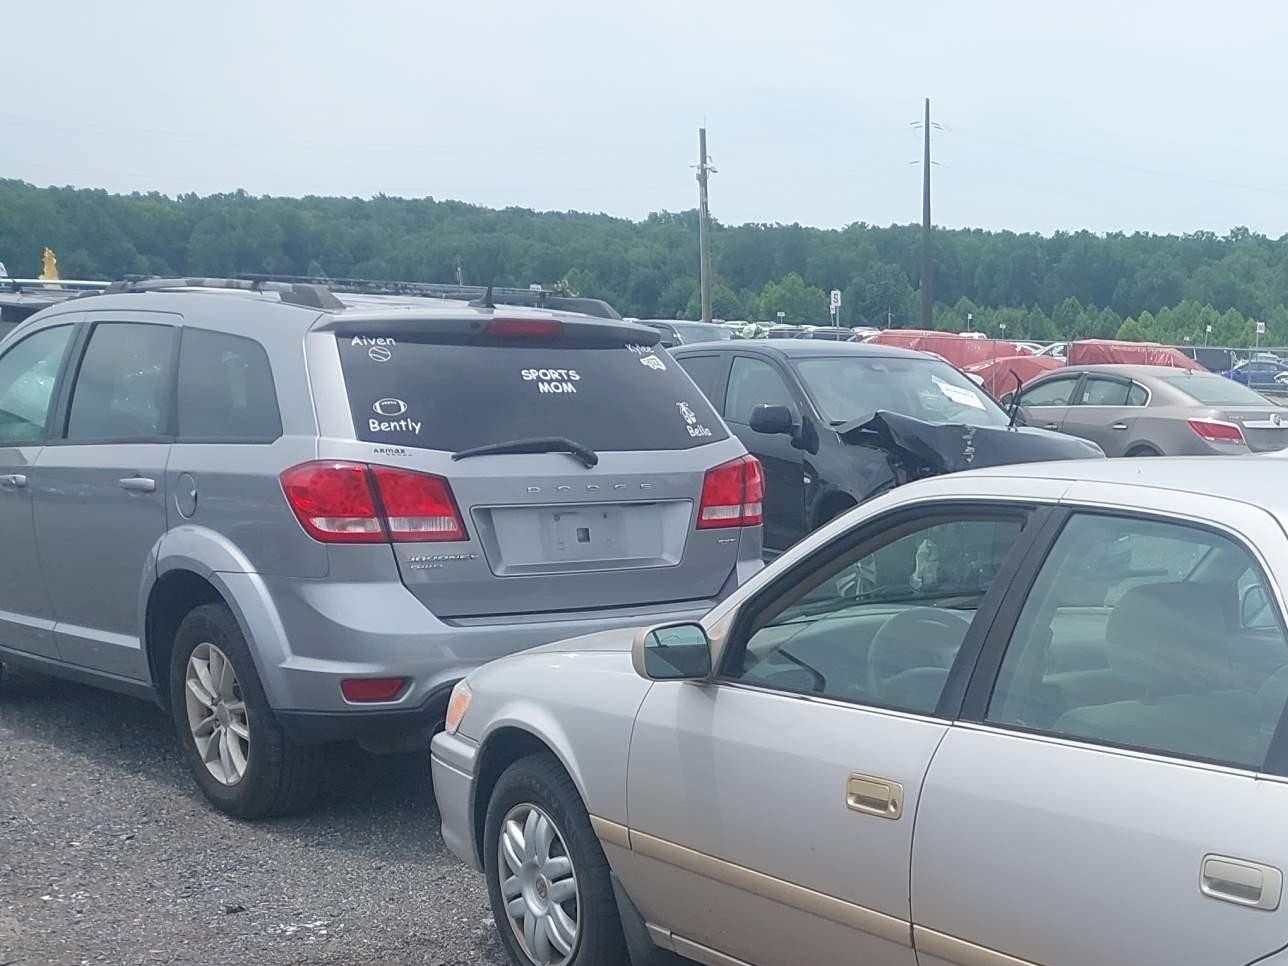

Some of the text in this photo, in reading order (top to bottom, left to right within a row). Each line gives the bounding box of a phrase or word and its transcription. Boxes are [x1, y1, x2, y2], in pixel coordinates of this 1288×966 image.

[833, 293, 839, 304] S
[351, 335, 396, 346] Aiven
[521, 369, 580, 381] SPORTS
[538, 381, 577, 393] MOM
[368, 418, 421, 434] Bently
[686, 424, 712, 437] Bella
